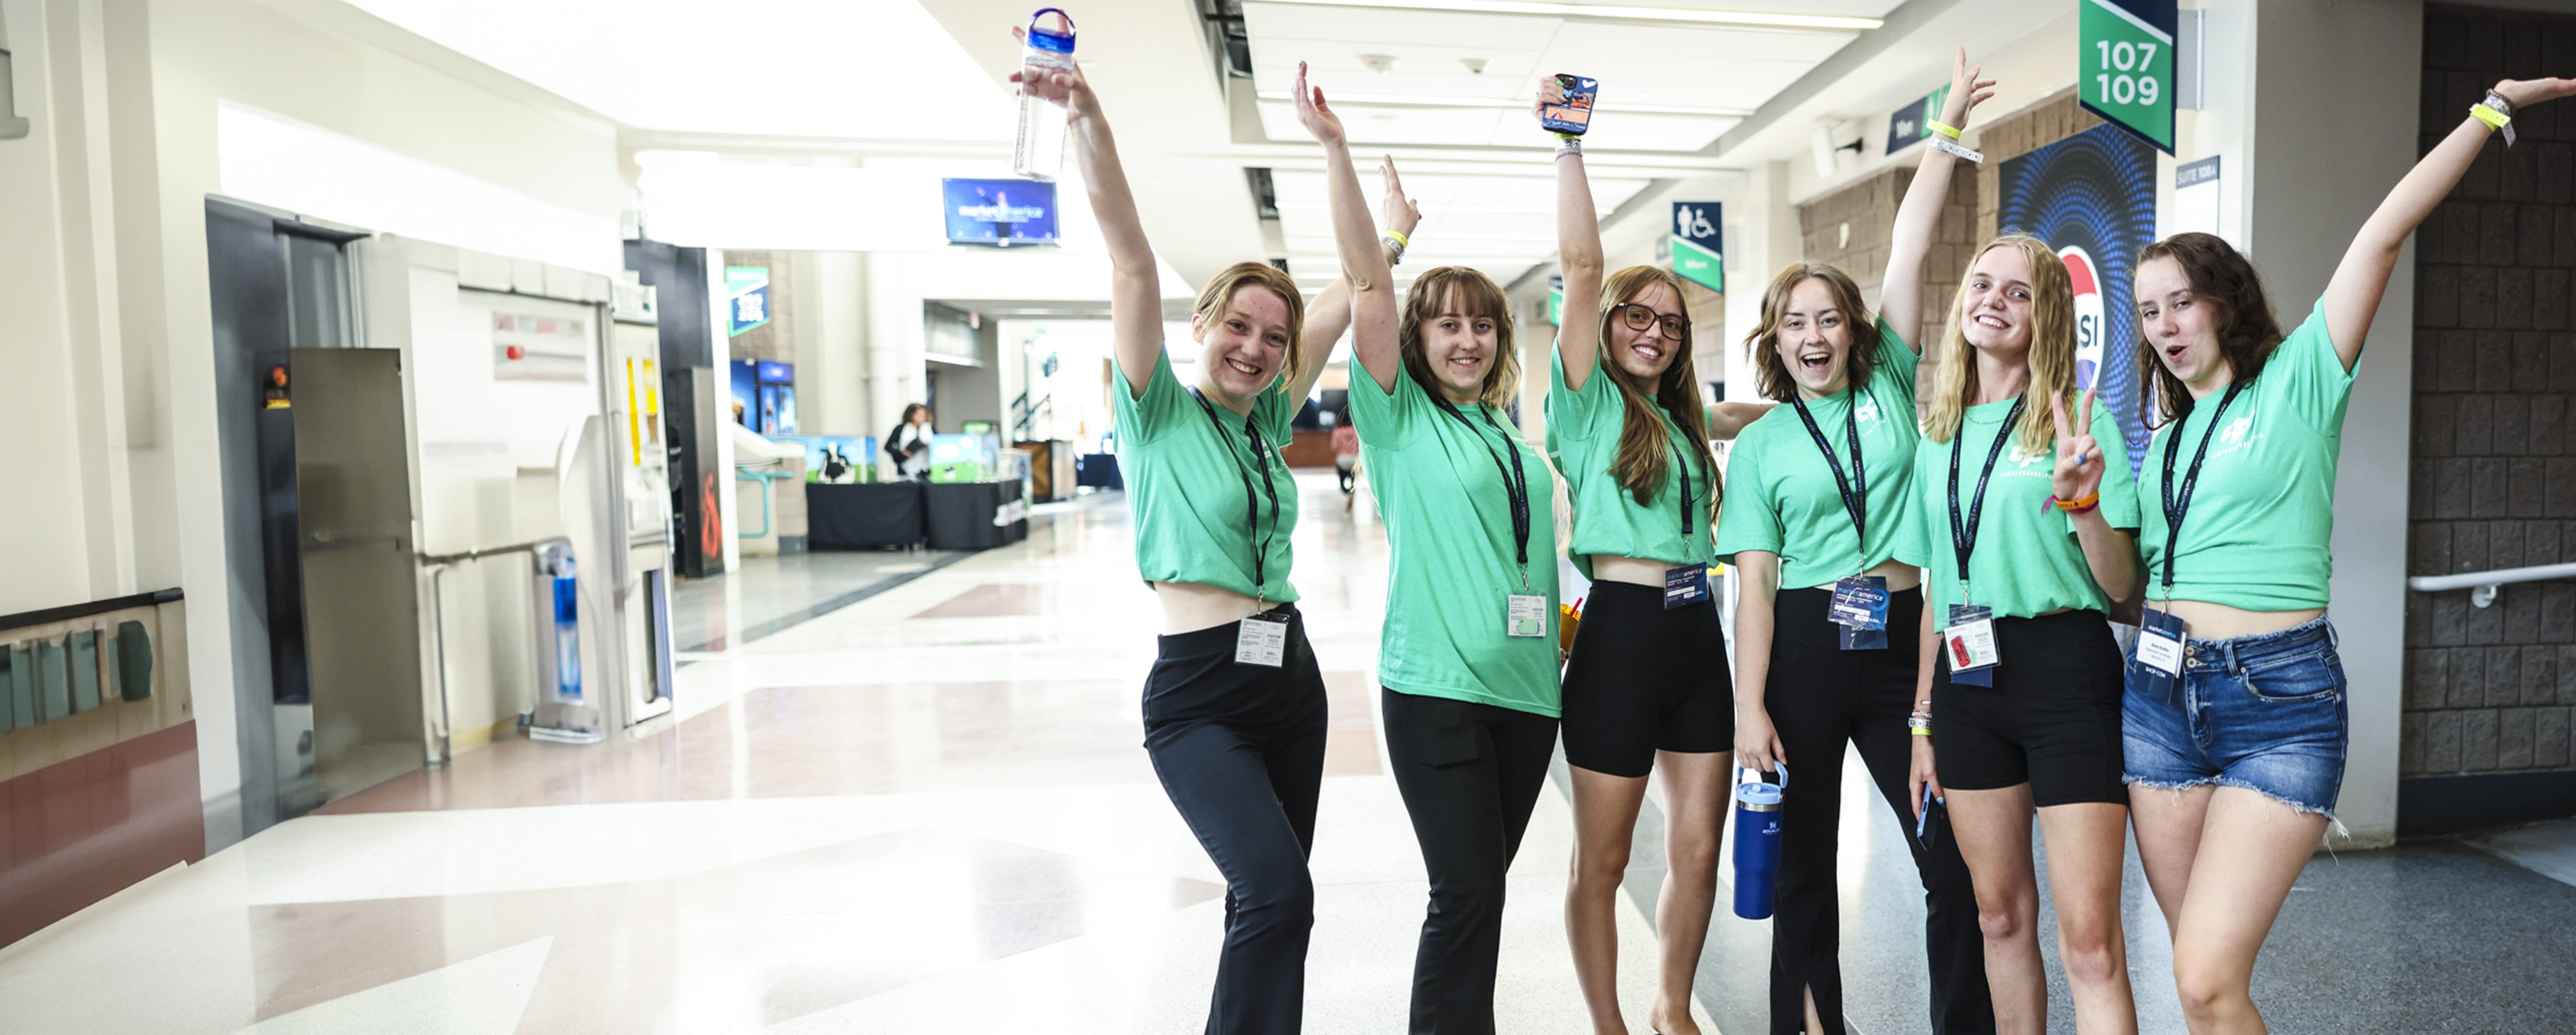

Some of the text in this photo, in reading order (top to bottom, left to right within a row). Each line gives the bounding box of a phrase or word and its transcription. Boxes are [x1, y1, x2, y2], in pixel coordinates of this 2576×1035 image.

[2097, 40, 2157, 72] 107
[2097, 74, 2158, 105] 109
[2178, 168, 2197, 185] SUITE
